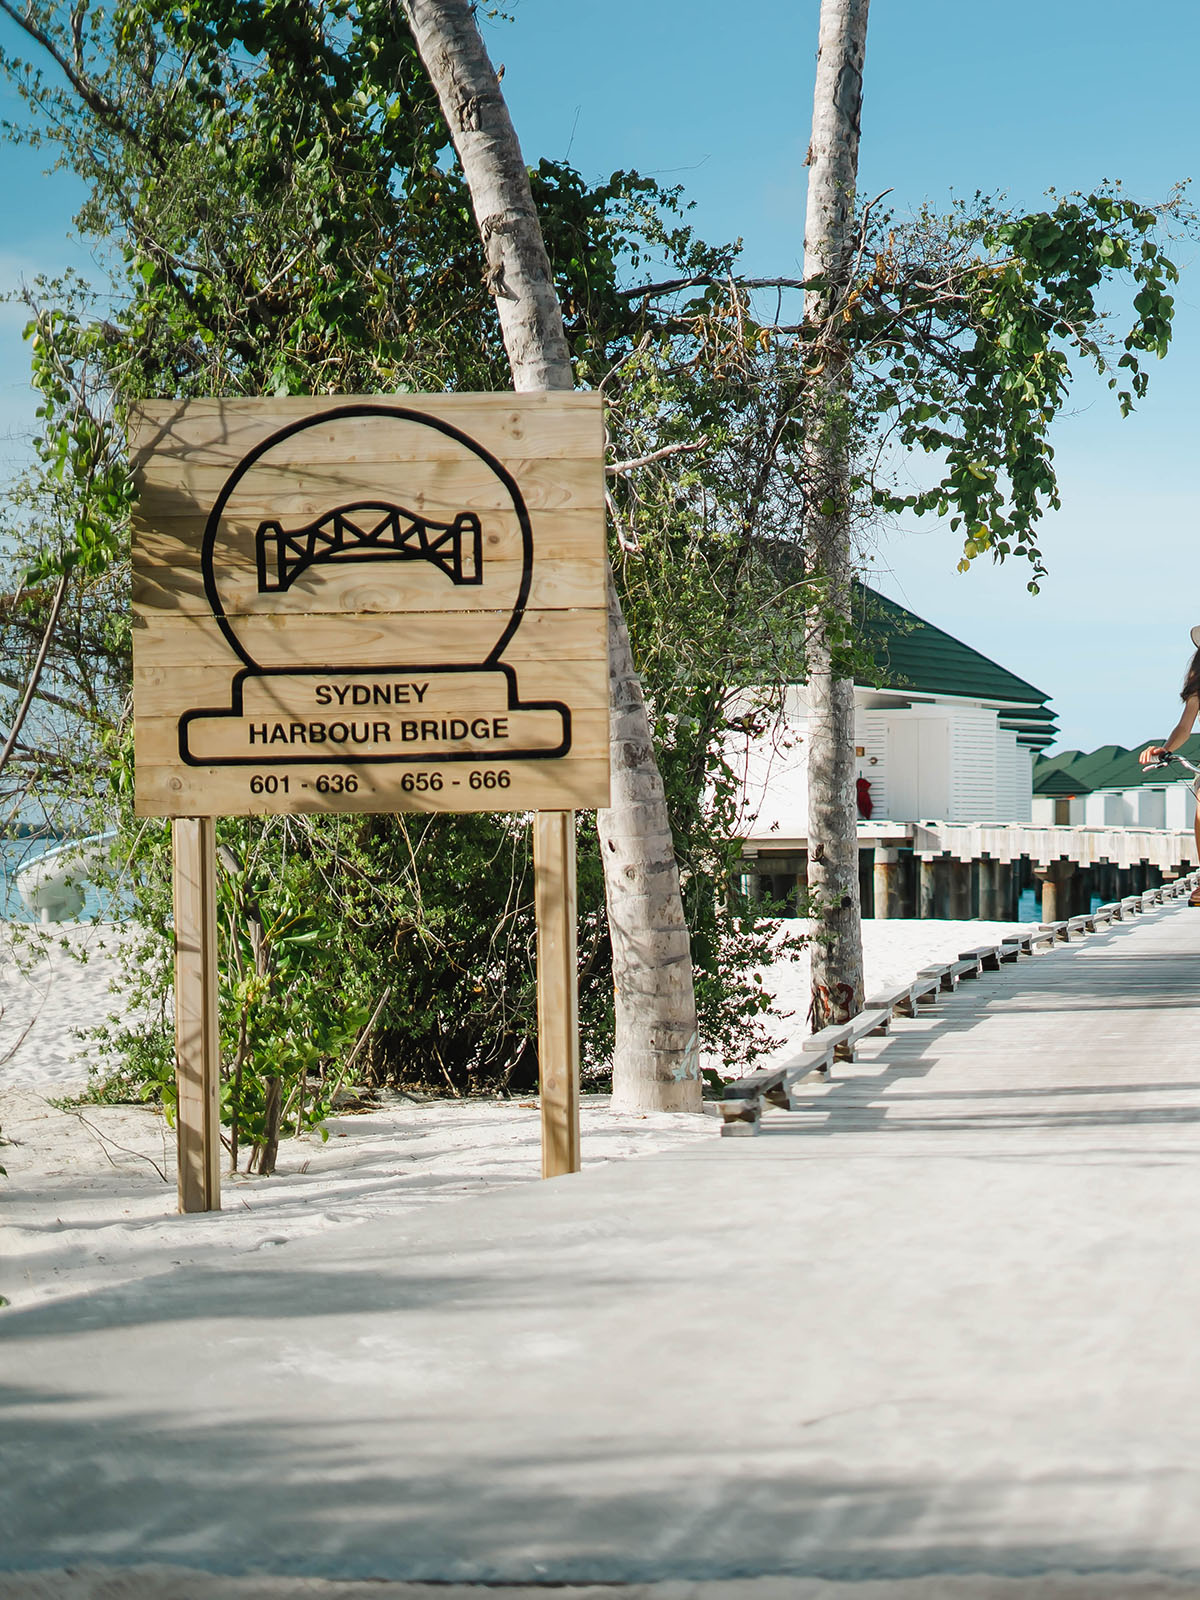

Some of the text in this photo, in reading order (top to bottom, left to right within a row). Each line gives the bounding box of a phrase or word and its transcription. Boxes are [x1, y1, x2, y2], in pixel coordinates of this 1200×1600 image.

[315, 684, 429, 706] SYDNEY
[249, 718, 509, 745] HARBOUR BRIDGE
[249, 775, 289, 794] 601
[315, 774, 359, 795] 636
[400, 772, 444, 794] 656
[469, 769, 511, 790] 666
